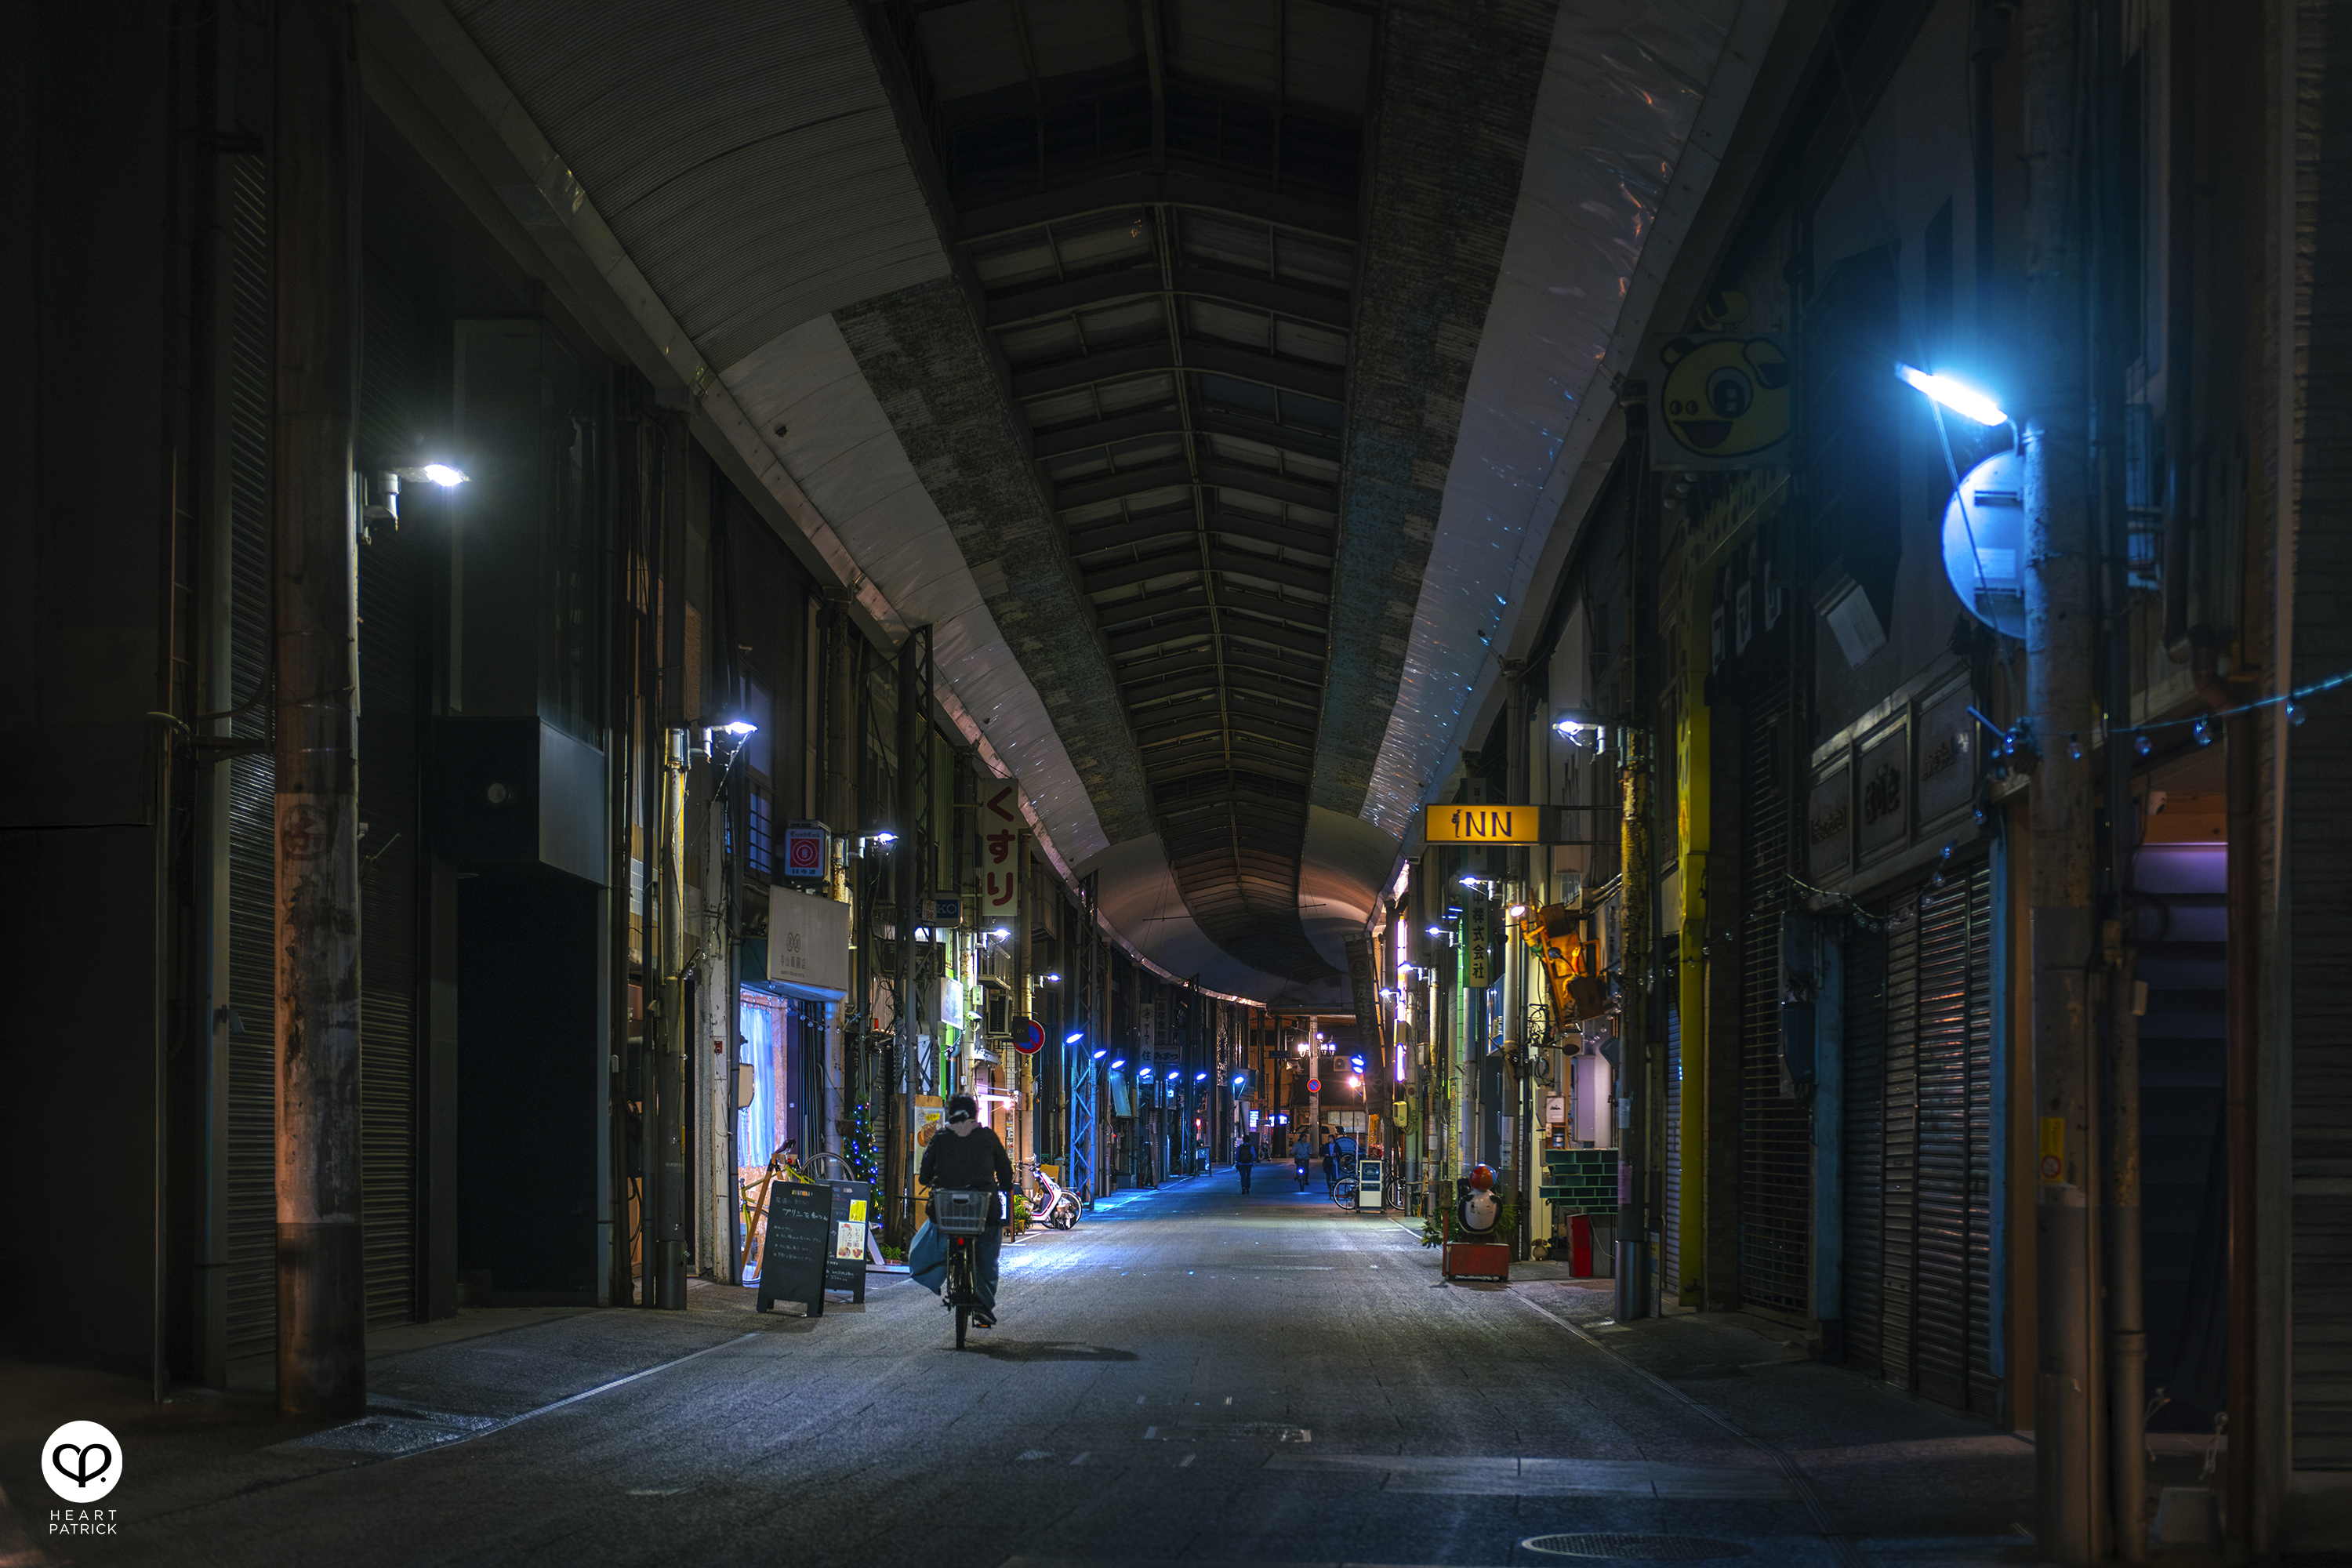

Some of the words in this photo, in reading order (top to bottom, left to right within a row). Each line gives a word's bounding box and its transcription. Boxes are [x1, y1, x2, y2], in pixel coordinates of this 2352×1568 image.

[986, 786, 1016, 907] くすり
[914, 903, 957, 915] SKO
